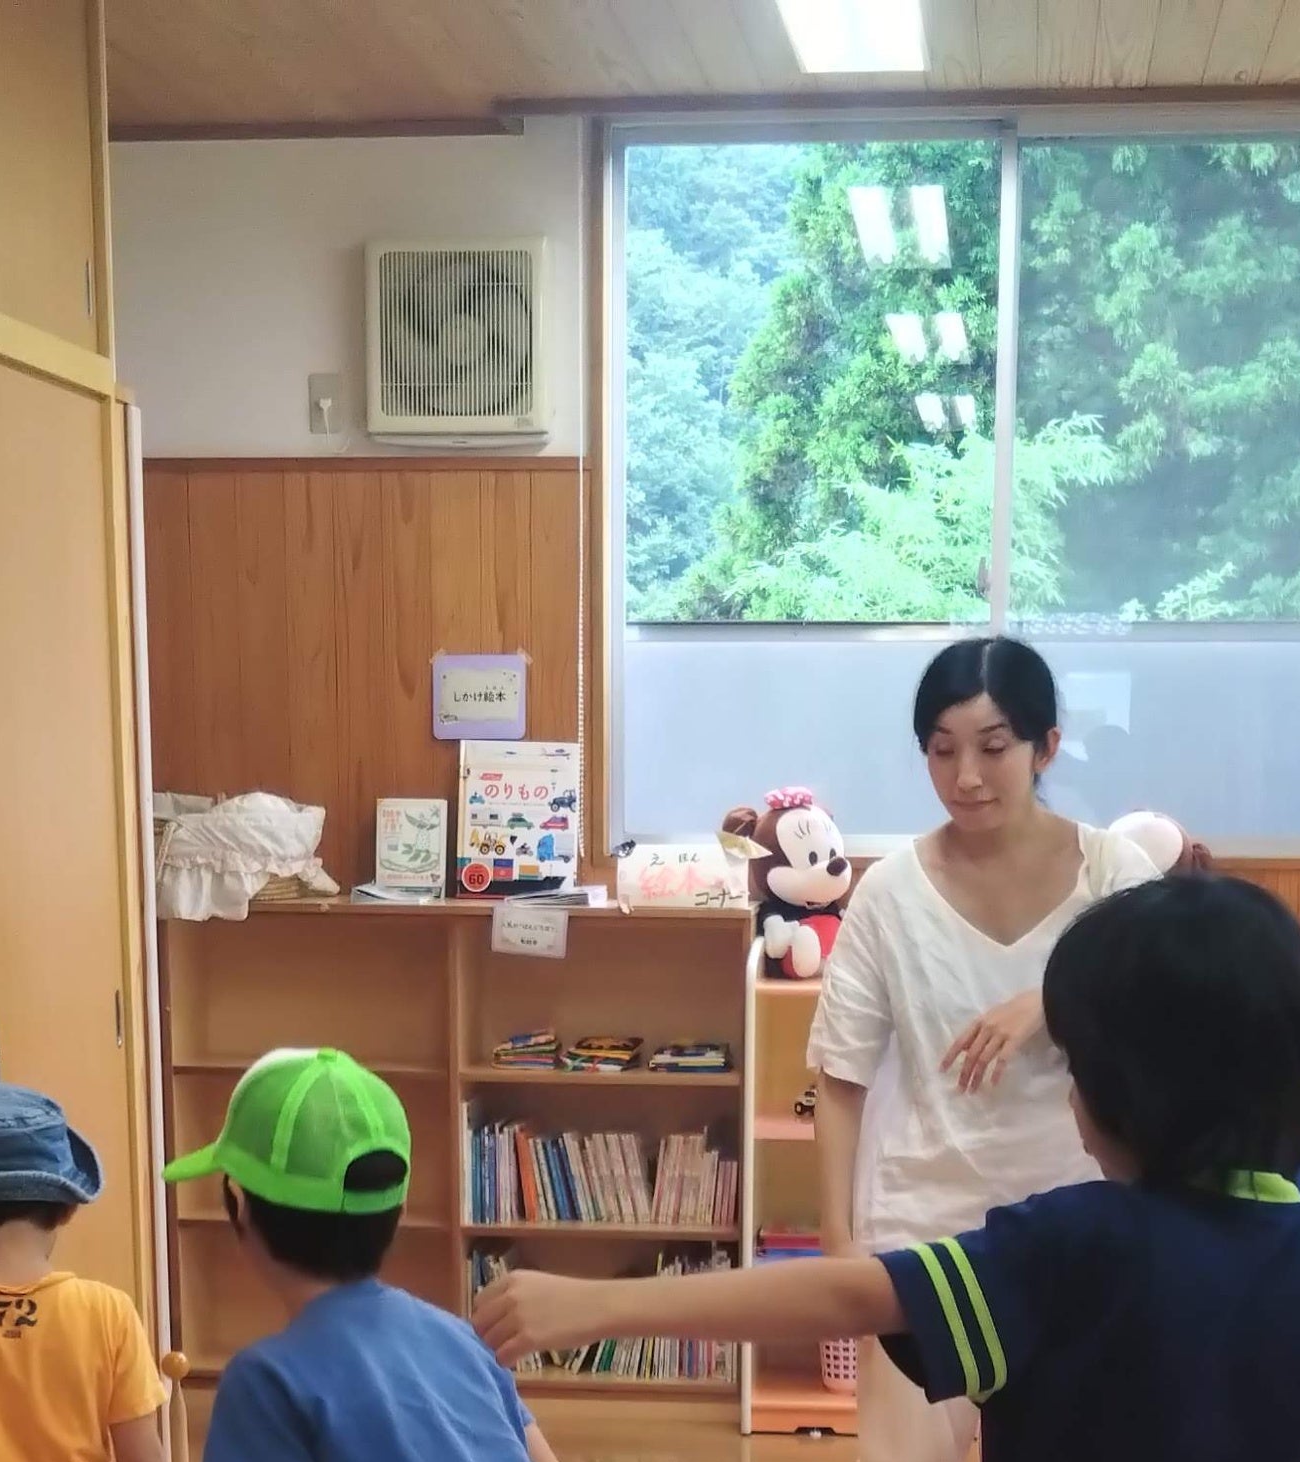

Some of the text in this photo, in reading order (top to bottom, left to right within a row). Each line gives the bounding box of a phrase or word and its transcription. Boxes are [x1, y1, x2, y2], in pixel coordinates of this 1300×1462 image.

[453, 691, 507, 703] しかけ絵本
[484, 782, 549, 801] のりもの
[468, 873, 485, 886] 60
[694, 887, 744, 908] コーナー
